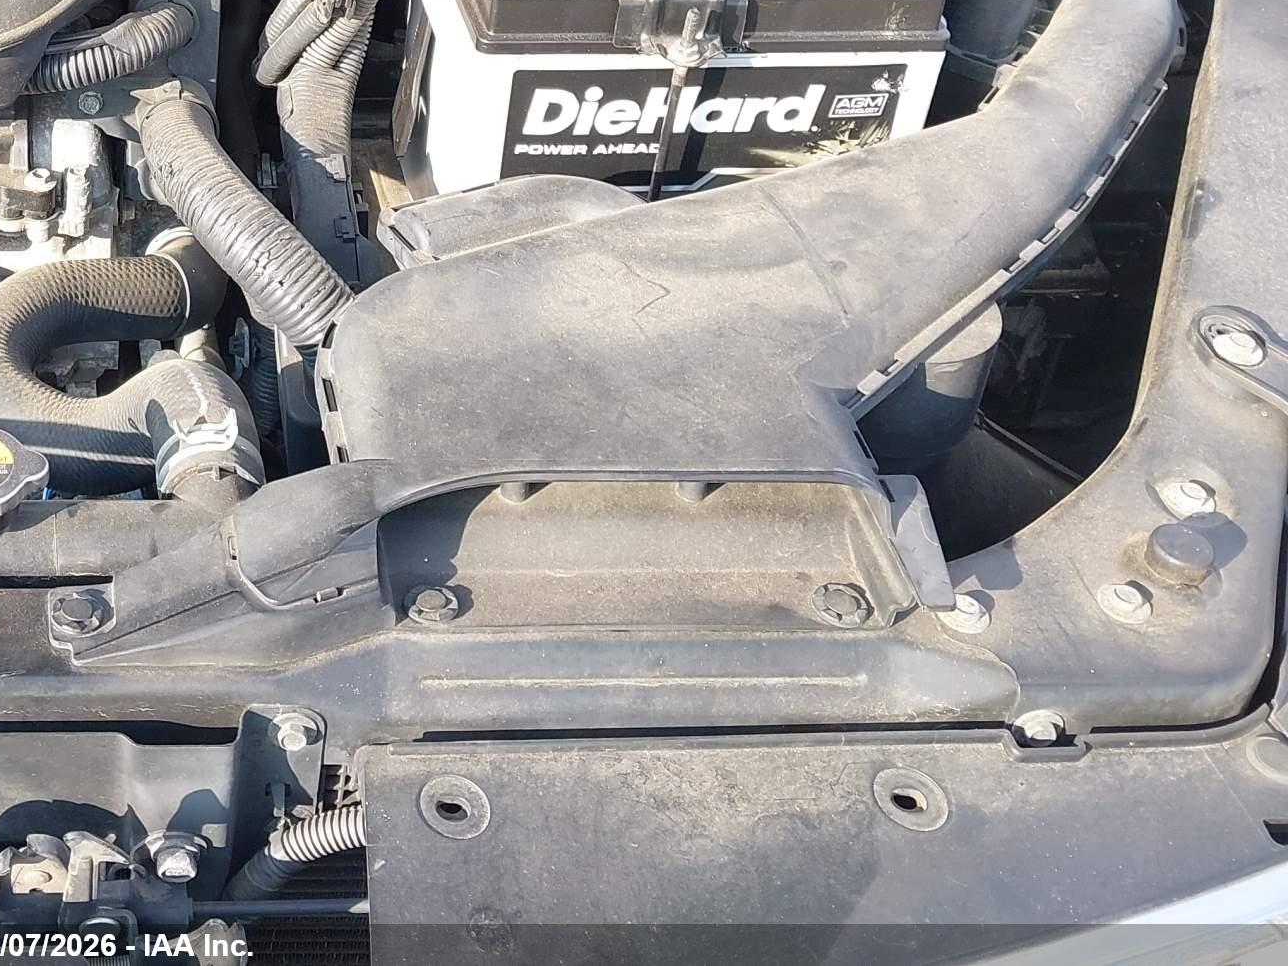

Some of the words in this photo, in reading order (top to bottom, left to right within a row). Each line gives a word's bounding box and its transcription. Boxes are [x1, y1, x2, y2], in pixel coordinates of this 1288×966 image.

[835, 96, 884, 109] AGM
[834, 107, 880, 115] TECHNOLOGY
[514, 144, 588, 155] POWER
